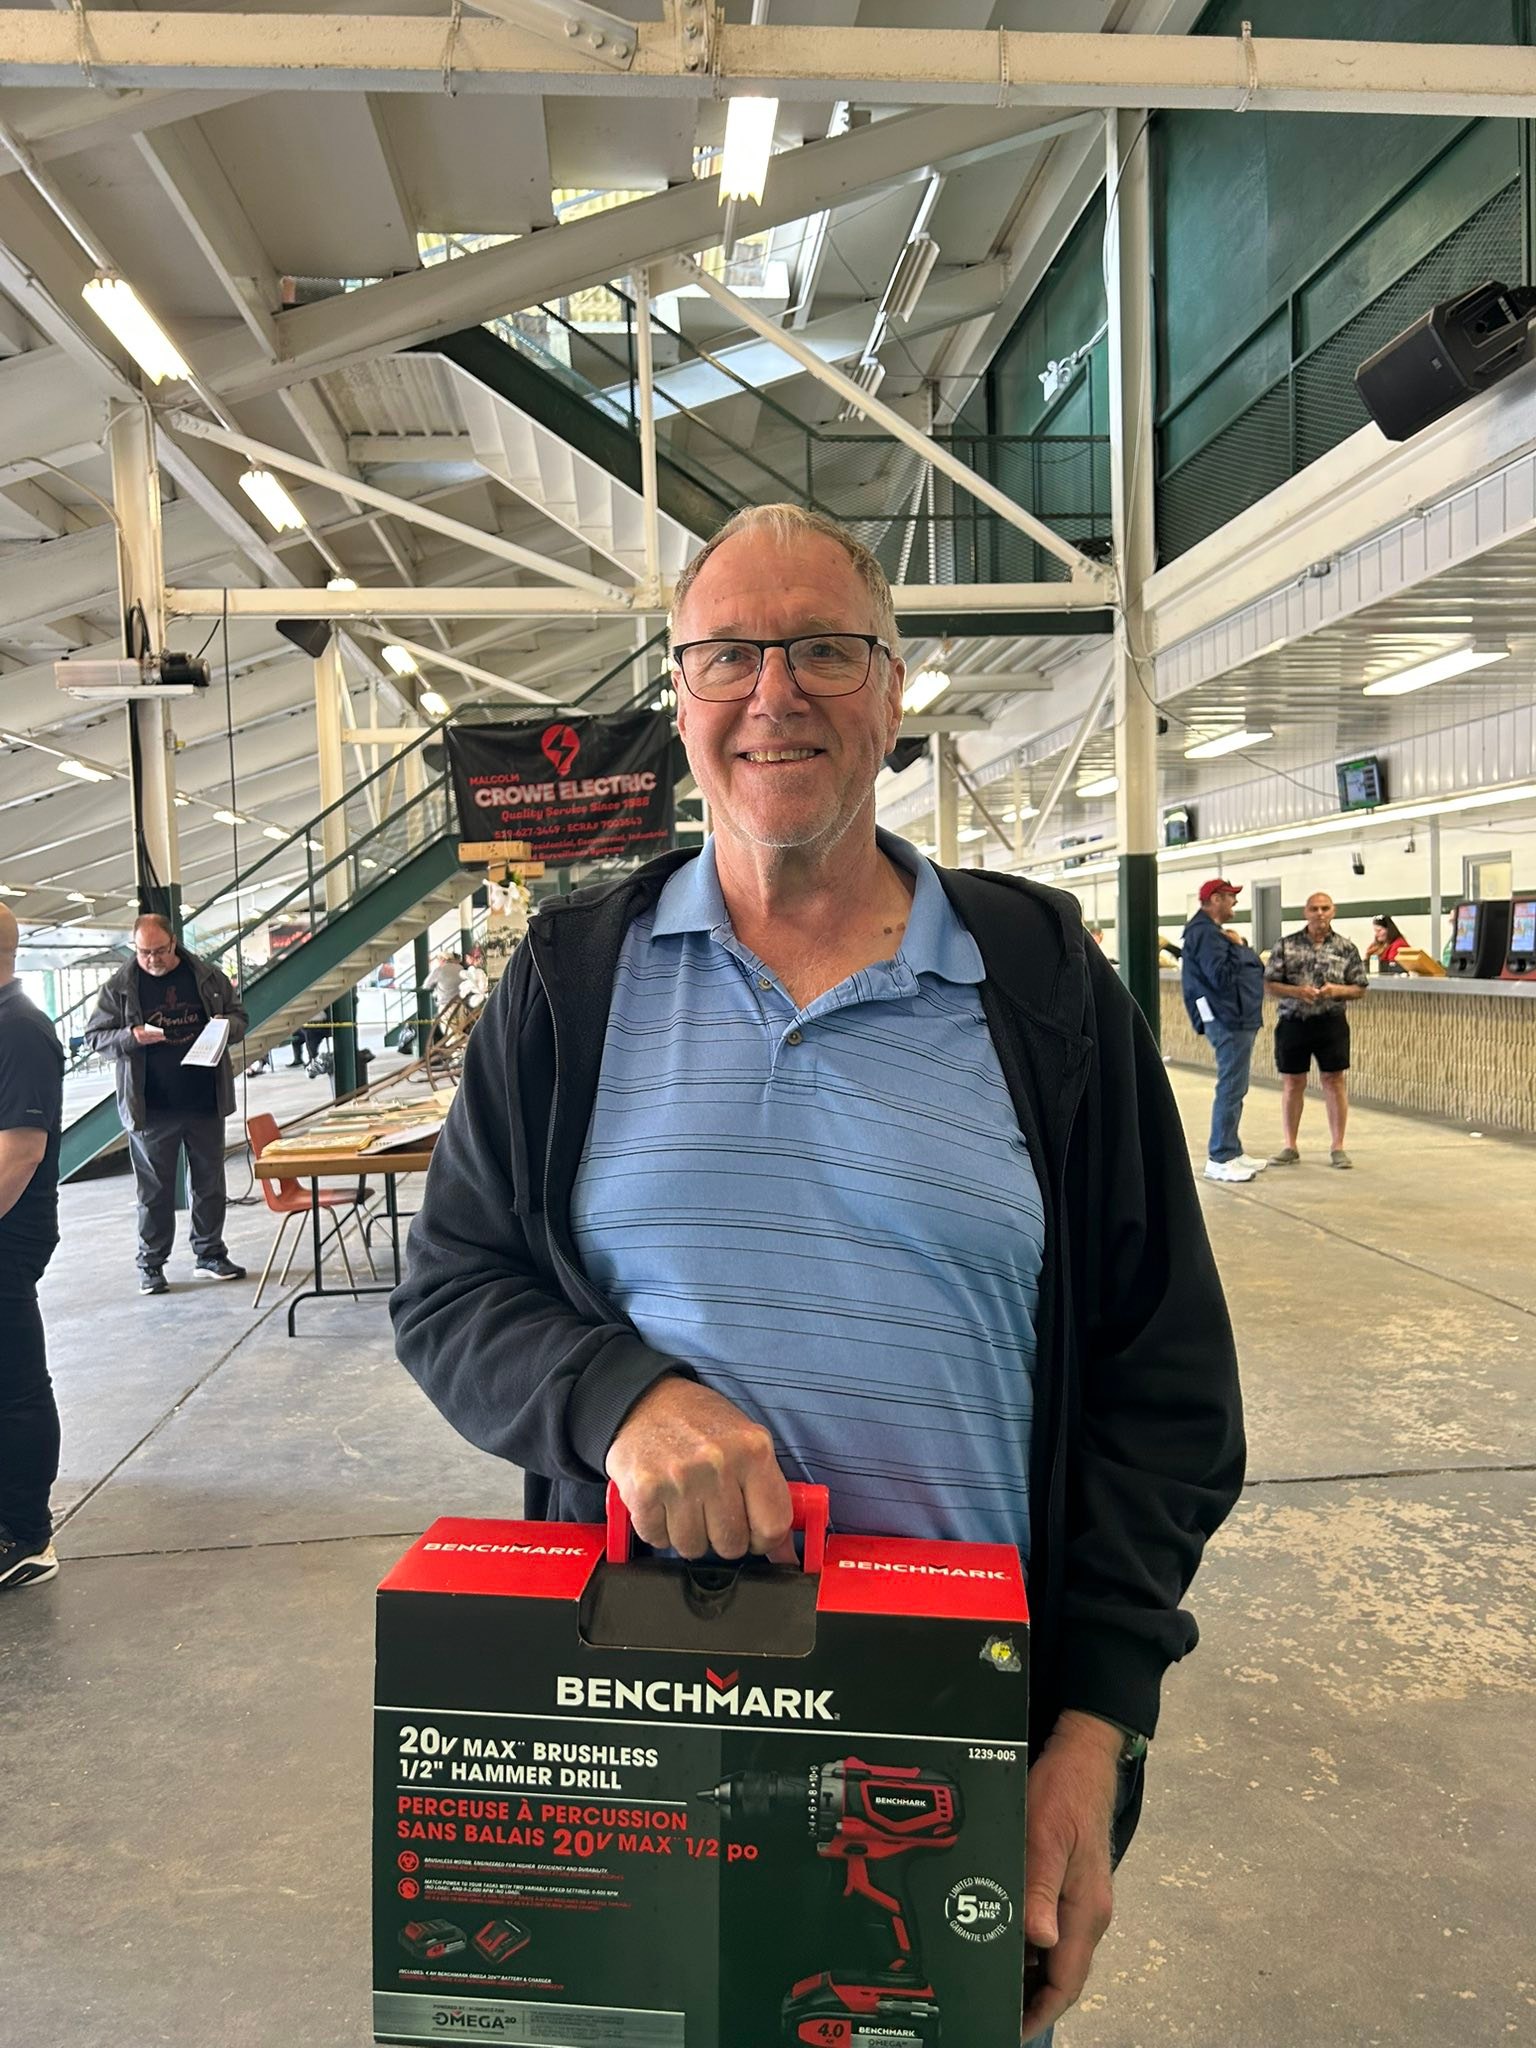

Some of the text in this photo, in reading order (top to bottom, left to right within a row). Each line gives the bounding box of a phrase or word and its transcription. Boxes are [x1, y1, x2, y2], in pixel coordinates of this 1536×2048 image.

[469, 774, 520, 785] MALCOLM
[474, 771, 657, 807] CROWE ELECTRIC
[501, 807, 544, 823] Quality
[545, 804, 588, 817] Service
[589, 801, 621, 812] Since
[423, 1541, 585, 1556] BENCHMARK
[838, 1559, 1007, 1580] BENCHMARK
[556, 1674, 835, 1721] BENCHMARK
[532, 1742, 659, 1768] BRUSHLESS
[968, 1747, 1017, 1761] 1239-005
[399, 1758, 622, 1790] 1/2" HAMMER DRILL
[397, 1795, 688, 1831] PERCEUSE À PERCUSSION
[875, 1796, 927, 1808] BENCHMARK
[397, 1820, 457, 1841] SANS
[464, 1823, 545, 1847] BALAIS
[685, 1837, 719, 1859] 1/2
[726, 1842, 759, 1862] po
[949, 1876, 1009, 1900] LIMITED WARRANTY
[956, 1894, 1001, 1924] 5 YEAR
[949, 1920, 981, 1942] GARANTIE
[817, 2022, 845, 2038] 4.0
[858, 2026, 916, 2037] BENCHMARK
